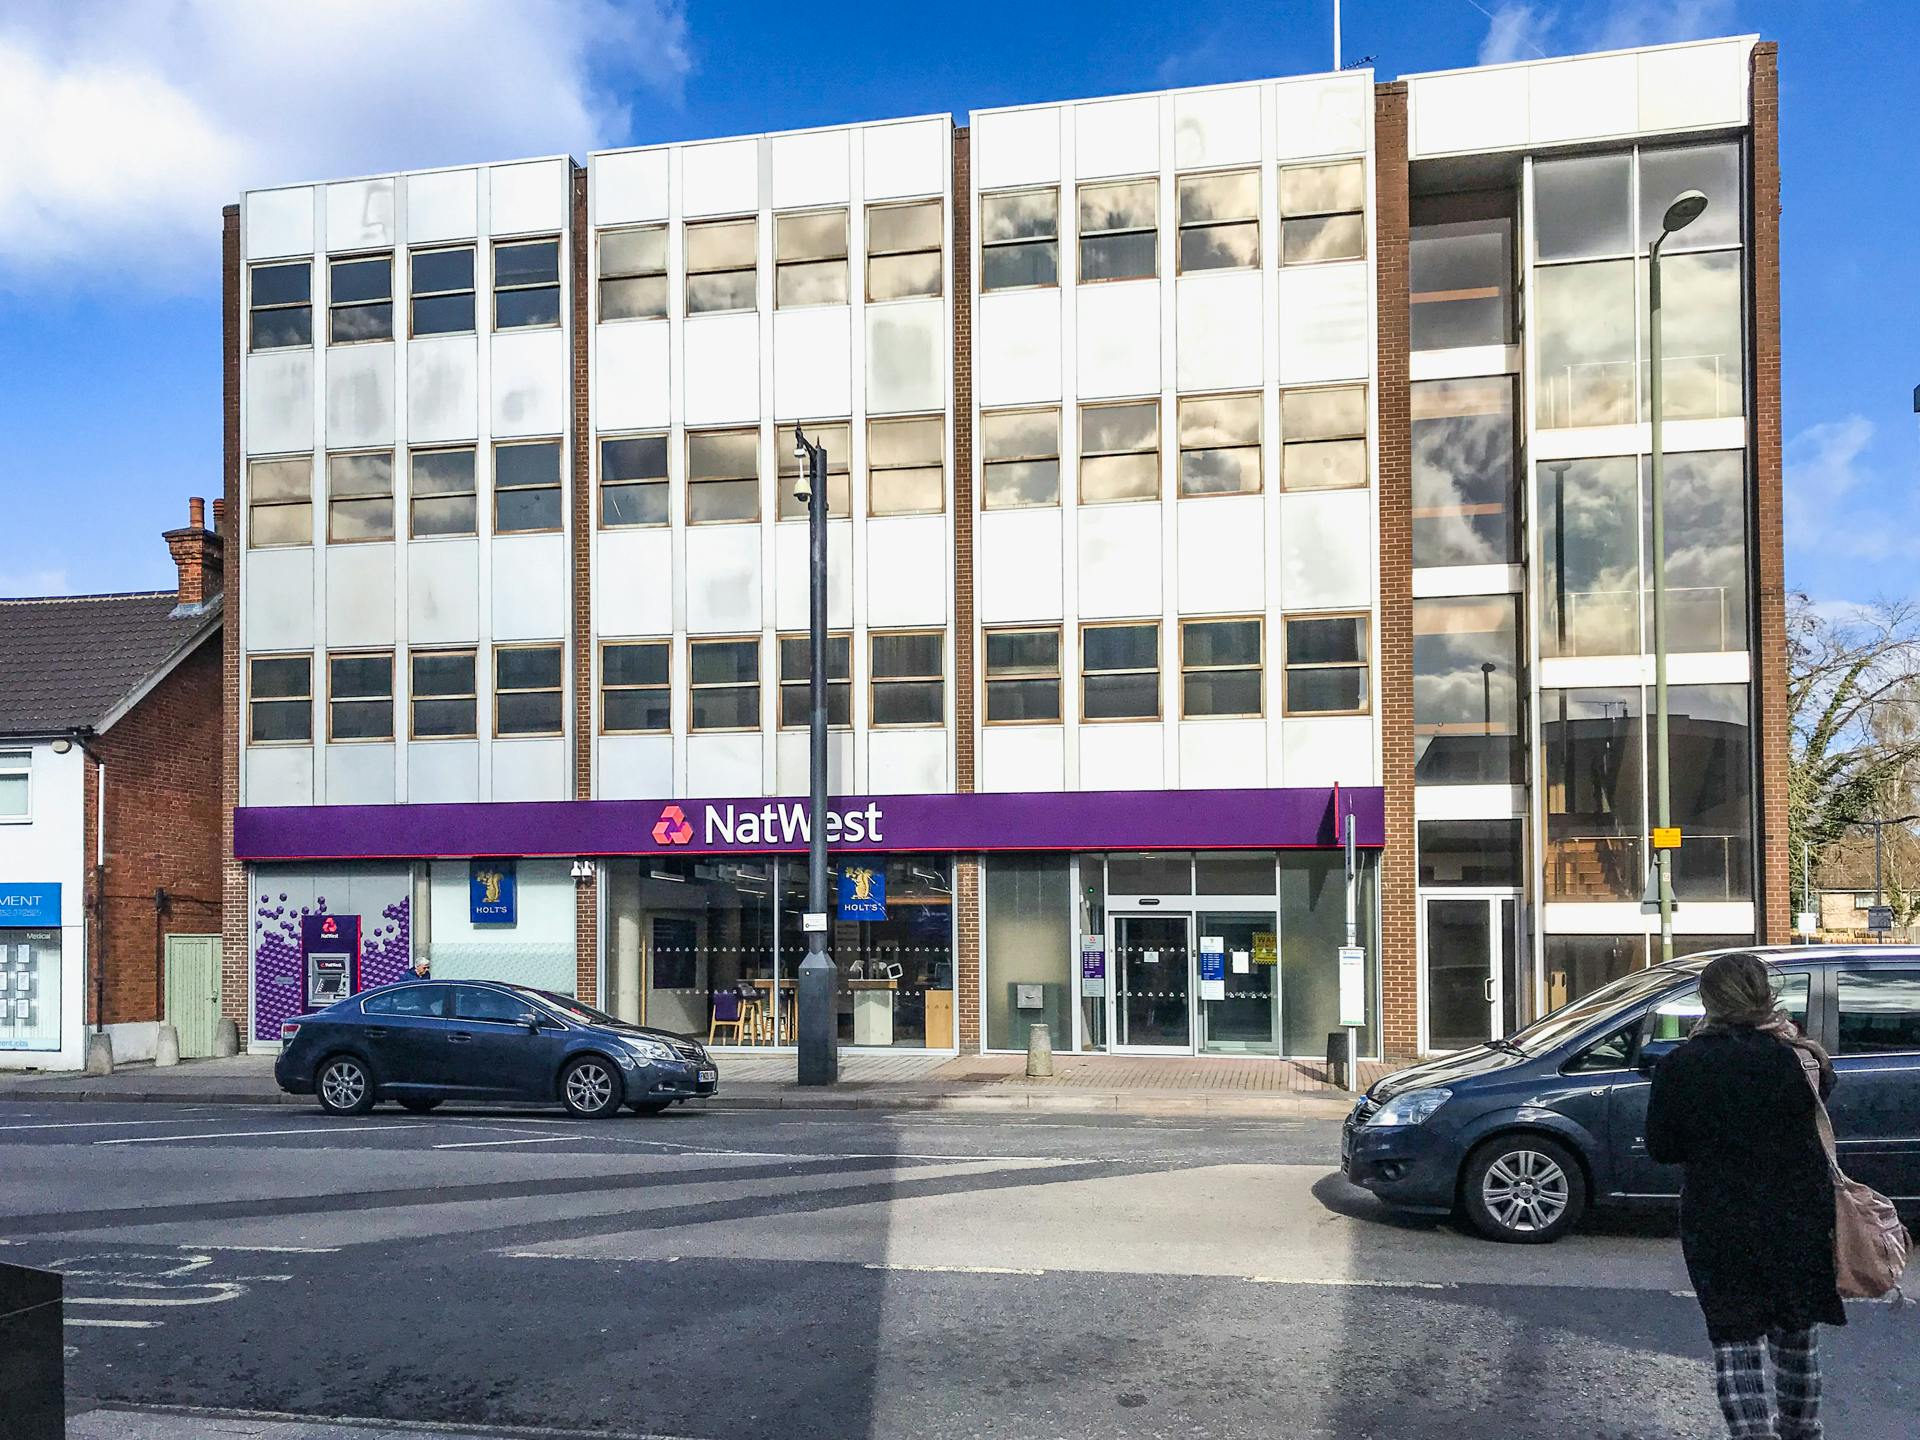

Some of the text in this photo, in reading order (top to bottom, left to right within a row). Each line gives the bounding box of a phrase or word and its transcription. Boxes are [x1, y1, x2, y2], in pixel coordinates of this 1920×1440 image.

[705, 802, 883, 844] NatWest
[476, 906, 507, 914] HOLT'S
[844, 903, 878, 911] HOLT'S
